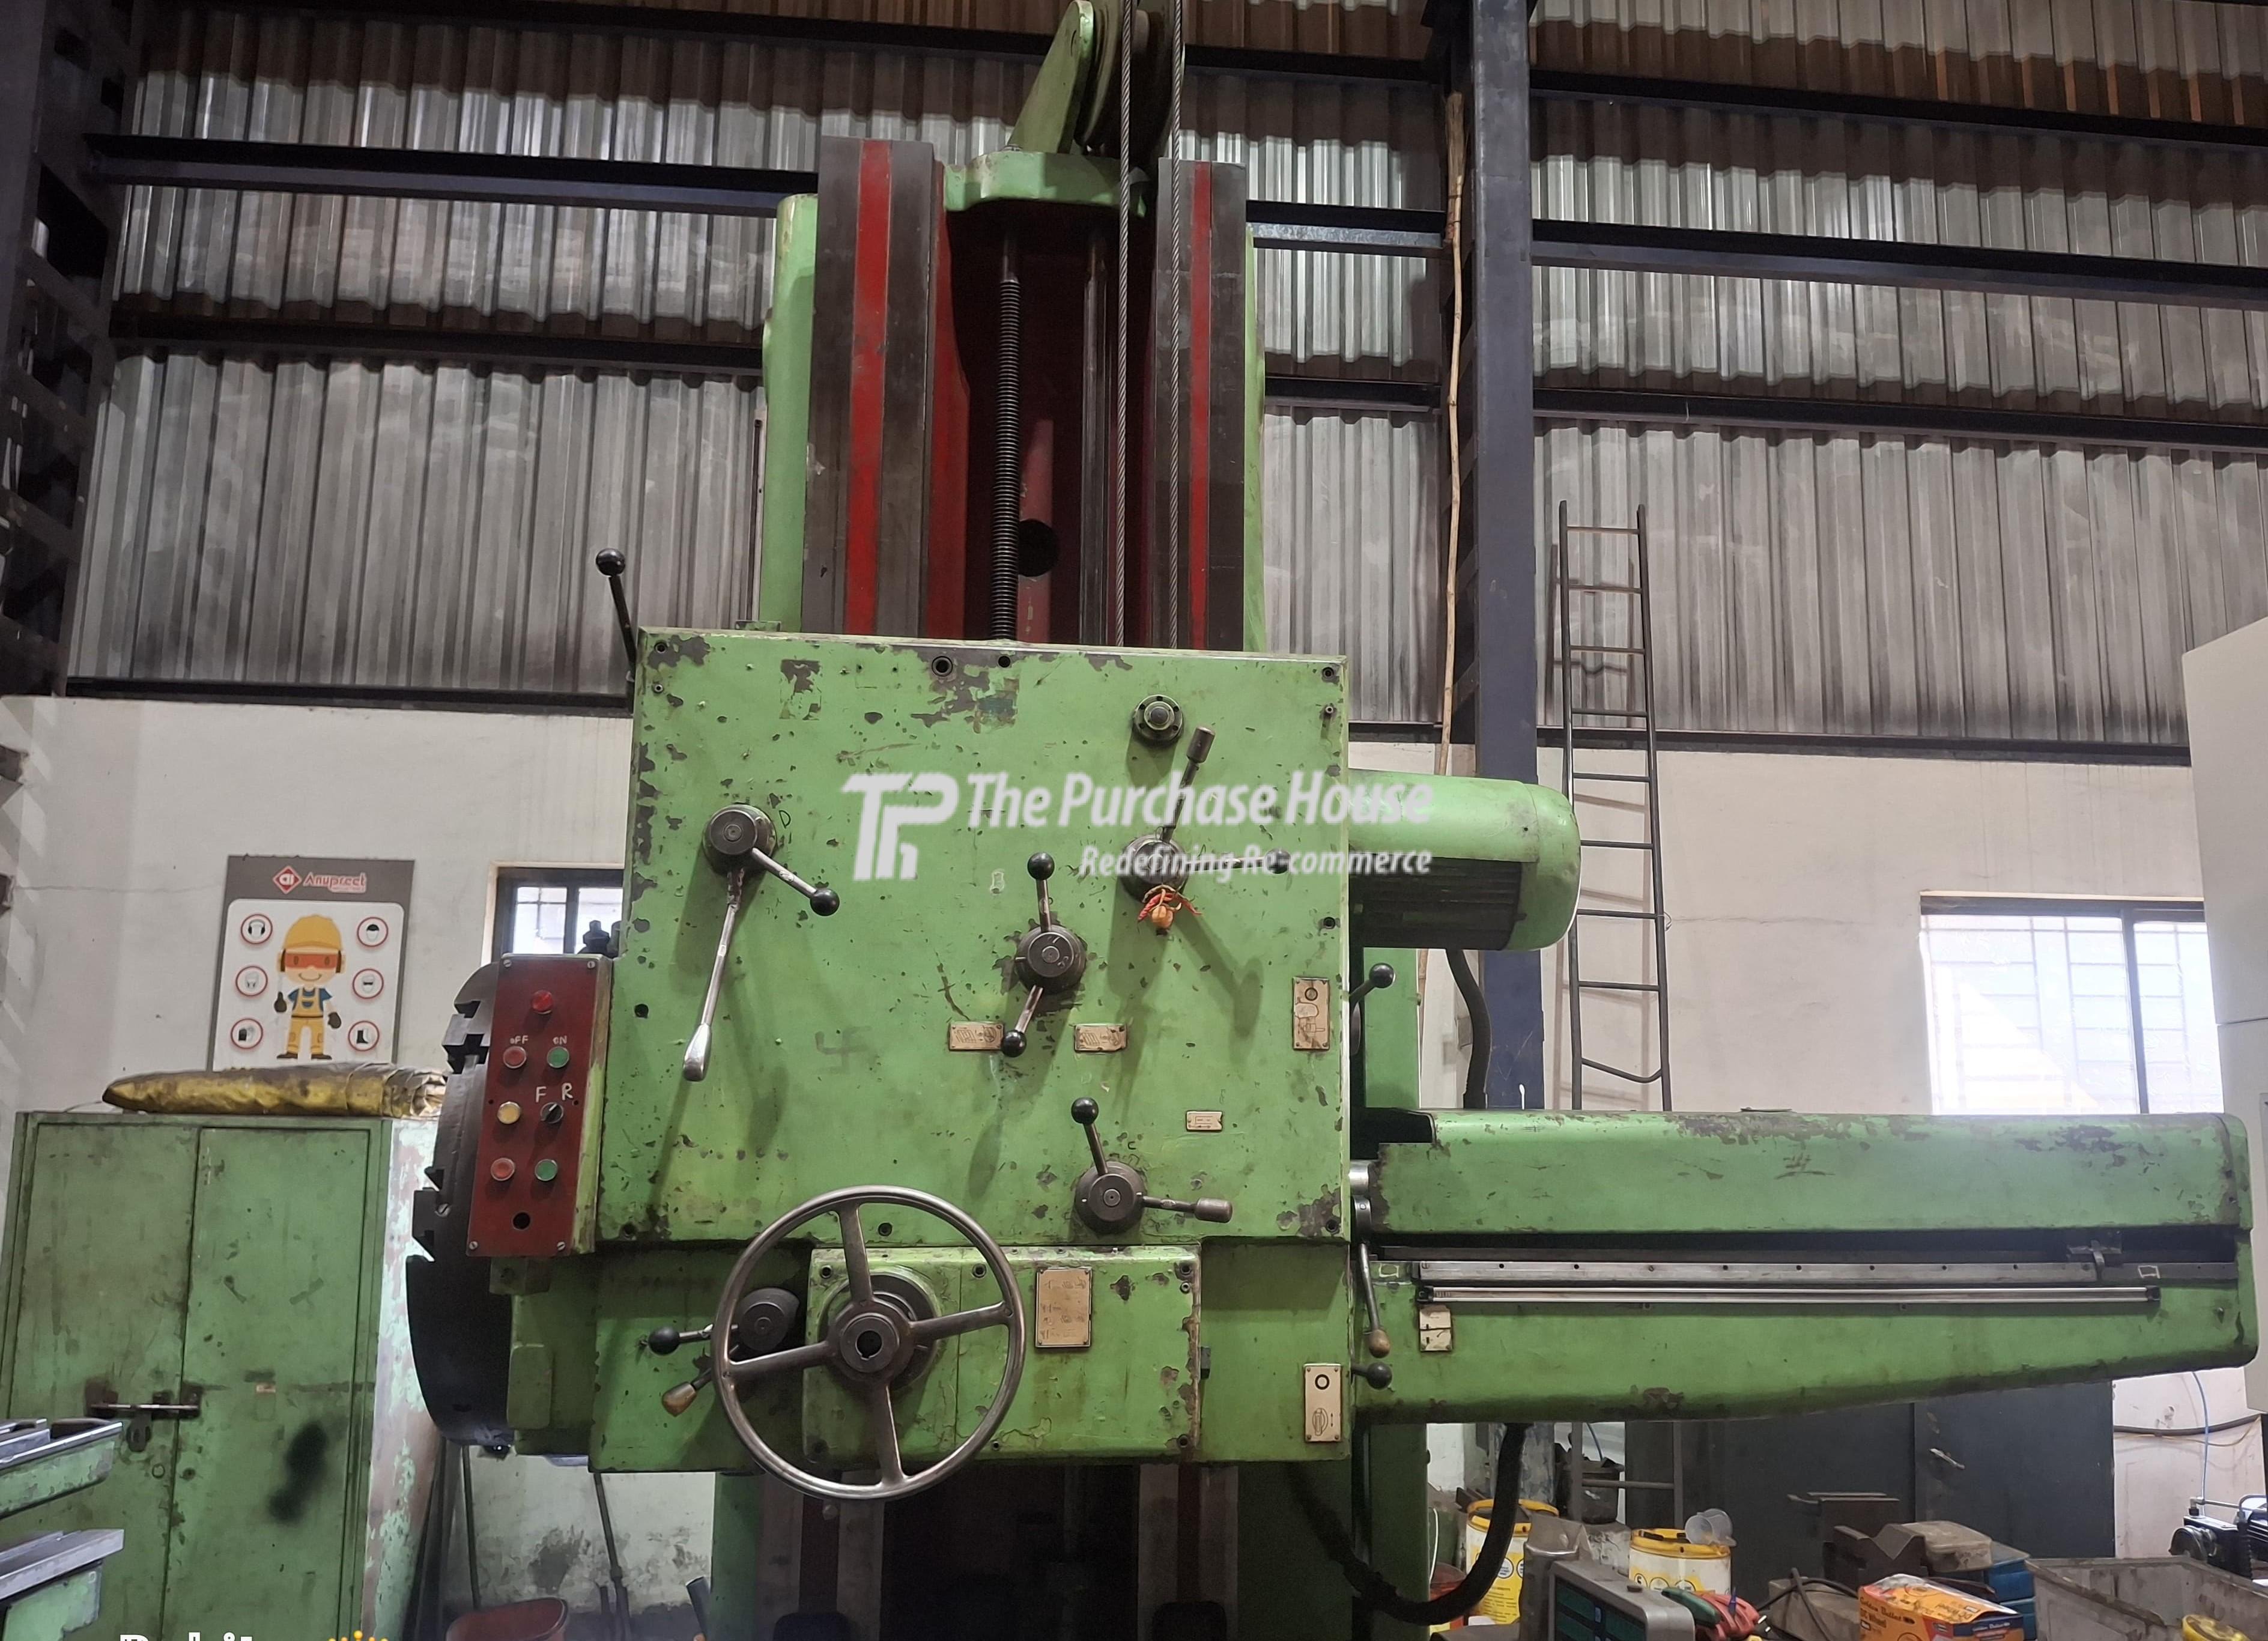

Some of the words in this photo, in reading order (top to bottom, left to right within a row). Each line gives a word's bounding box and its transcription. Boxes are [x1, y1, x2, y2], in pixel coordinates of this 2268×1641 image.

[553, 1035, 568, 1045] ON
[535, 1086, 547, 1103] F
[562, 1082, 574, 1100] R
